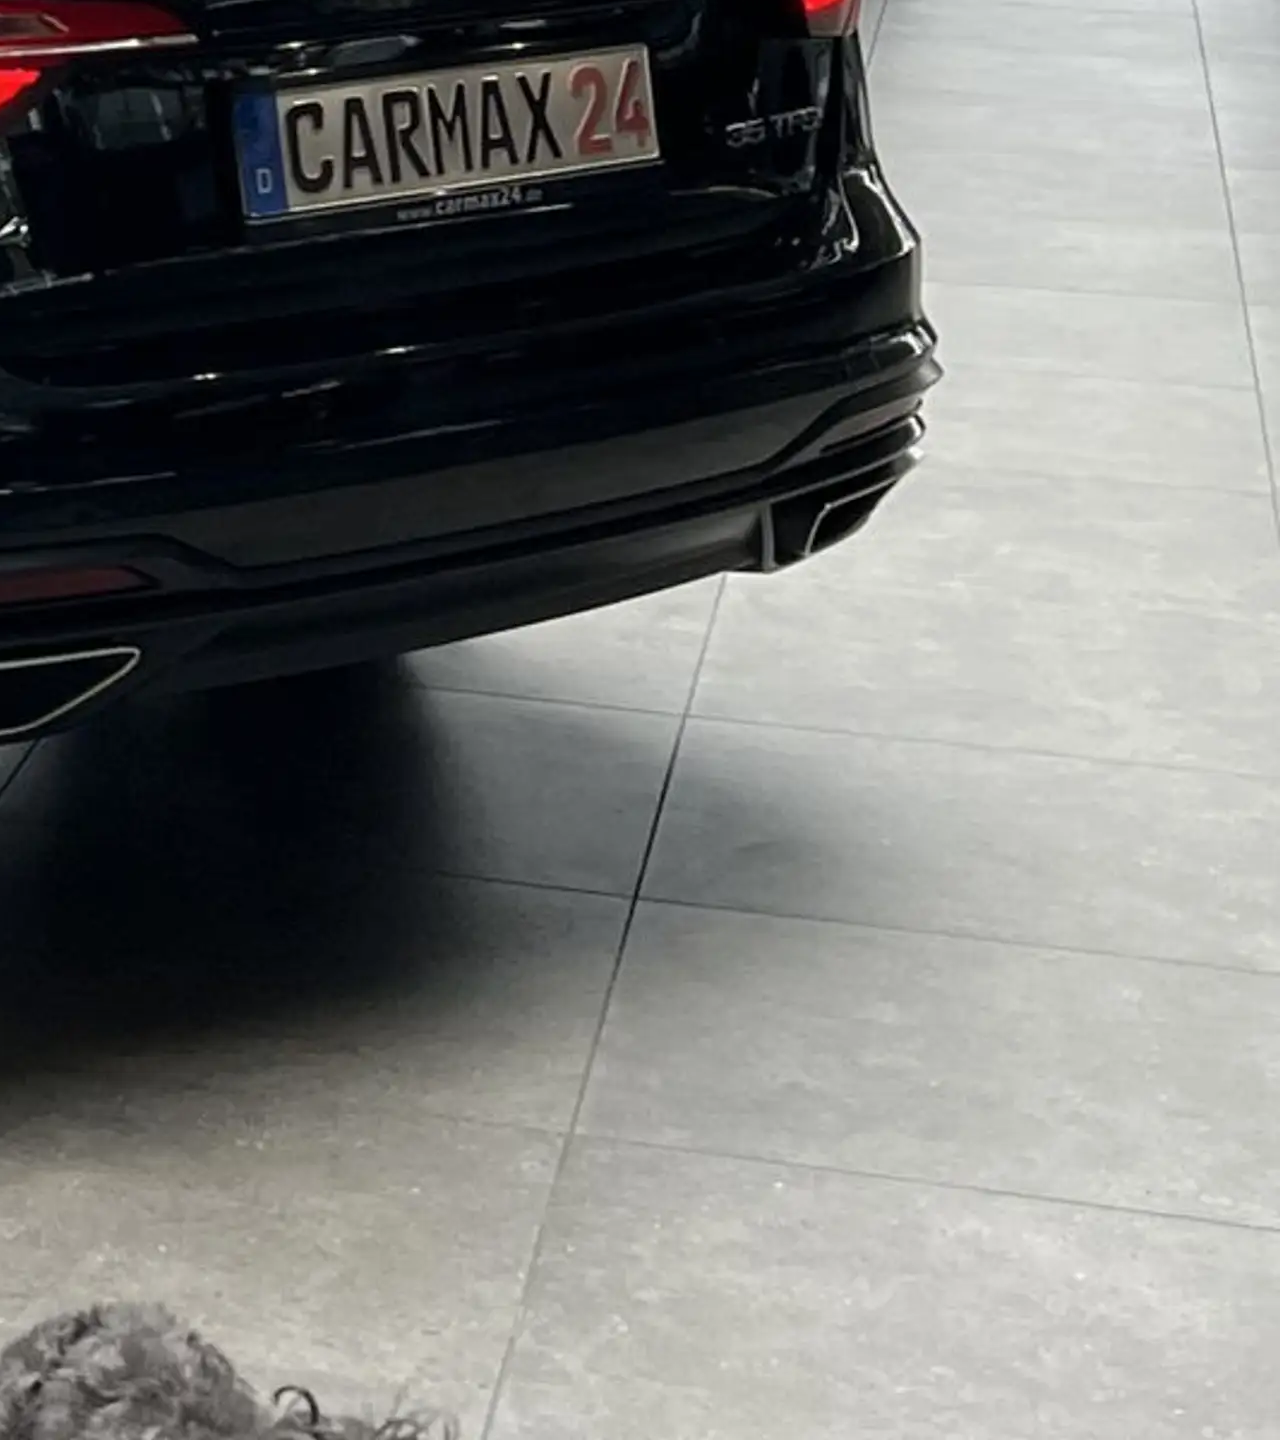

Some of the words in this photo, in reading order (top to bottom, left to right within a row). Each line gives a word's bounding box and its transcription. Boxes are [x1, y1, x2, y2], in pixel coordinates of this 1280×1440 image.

[284, 59, 651, 194] CARMAX24
[725, 117, 765, 148] 35
[256, 167, 274, 195] D
